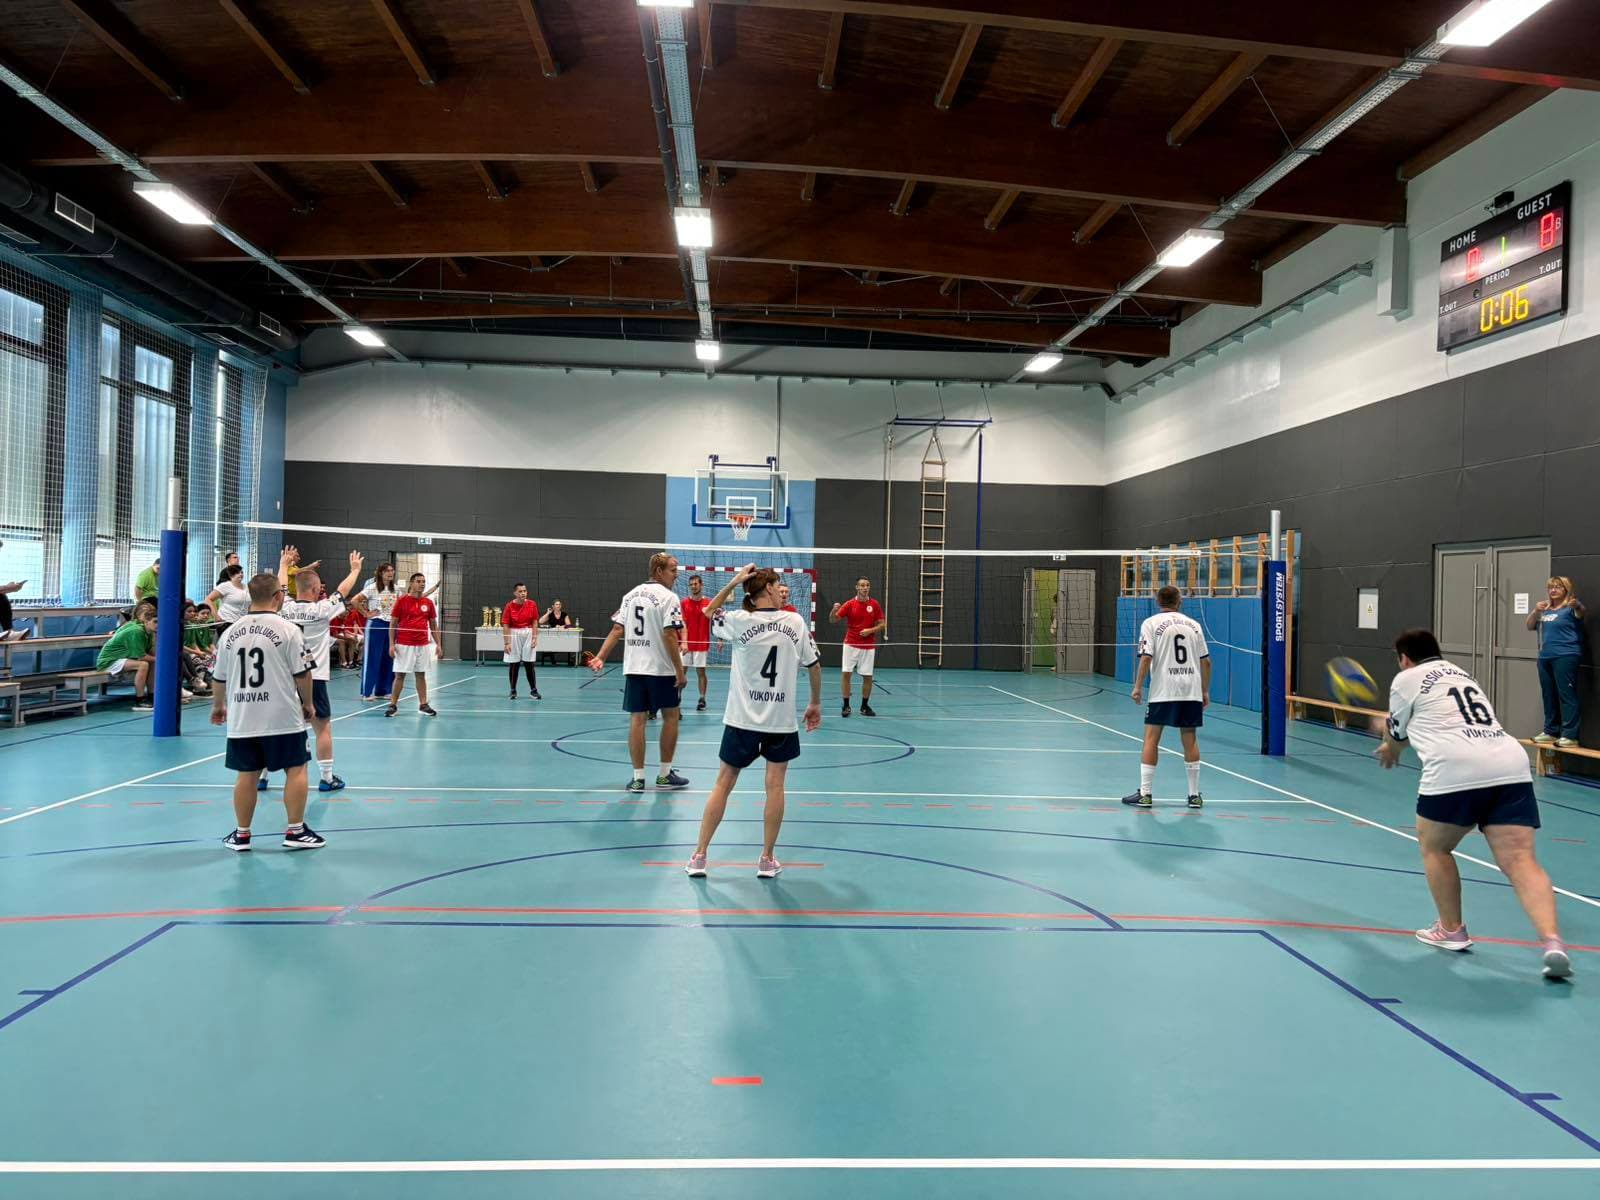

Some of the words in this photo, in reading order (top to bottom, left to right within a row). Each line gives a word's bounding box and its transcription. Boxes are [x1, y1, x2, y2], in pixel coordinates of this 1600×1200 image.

[1517, 193, 1552, 220] GUEST
[1449, 231, 1477, 252] HOME
[1541, 212, 1555, 250] 8
[1467, 247, 1480, 281] 0
[1485, 269, 1510, 285] PERIOD
[1539, 259, 1561, 275] T.OUT
[1440, 301, 1457, 314] T.OUT
[1480, 285, 1529, 333] 0:06
[634, 606, 644, 636] 5
[740, 623, 765, 645] UZOSIO
[767, 622, 800, 645] GOLUBICA
[249, 625, 282, 648] GOLUBICA
[1174, 633, 1187, 665] 6
[237, 647, 265, 689] 13
[760, 645, 778, 688] 4
[749, 690, 786, 703] VUKOVAR
[1447, 686, 1493, 726] 16
